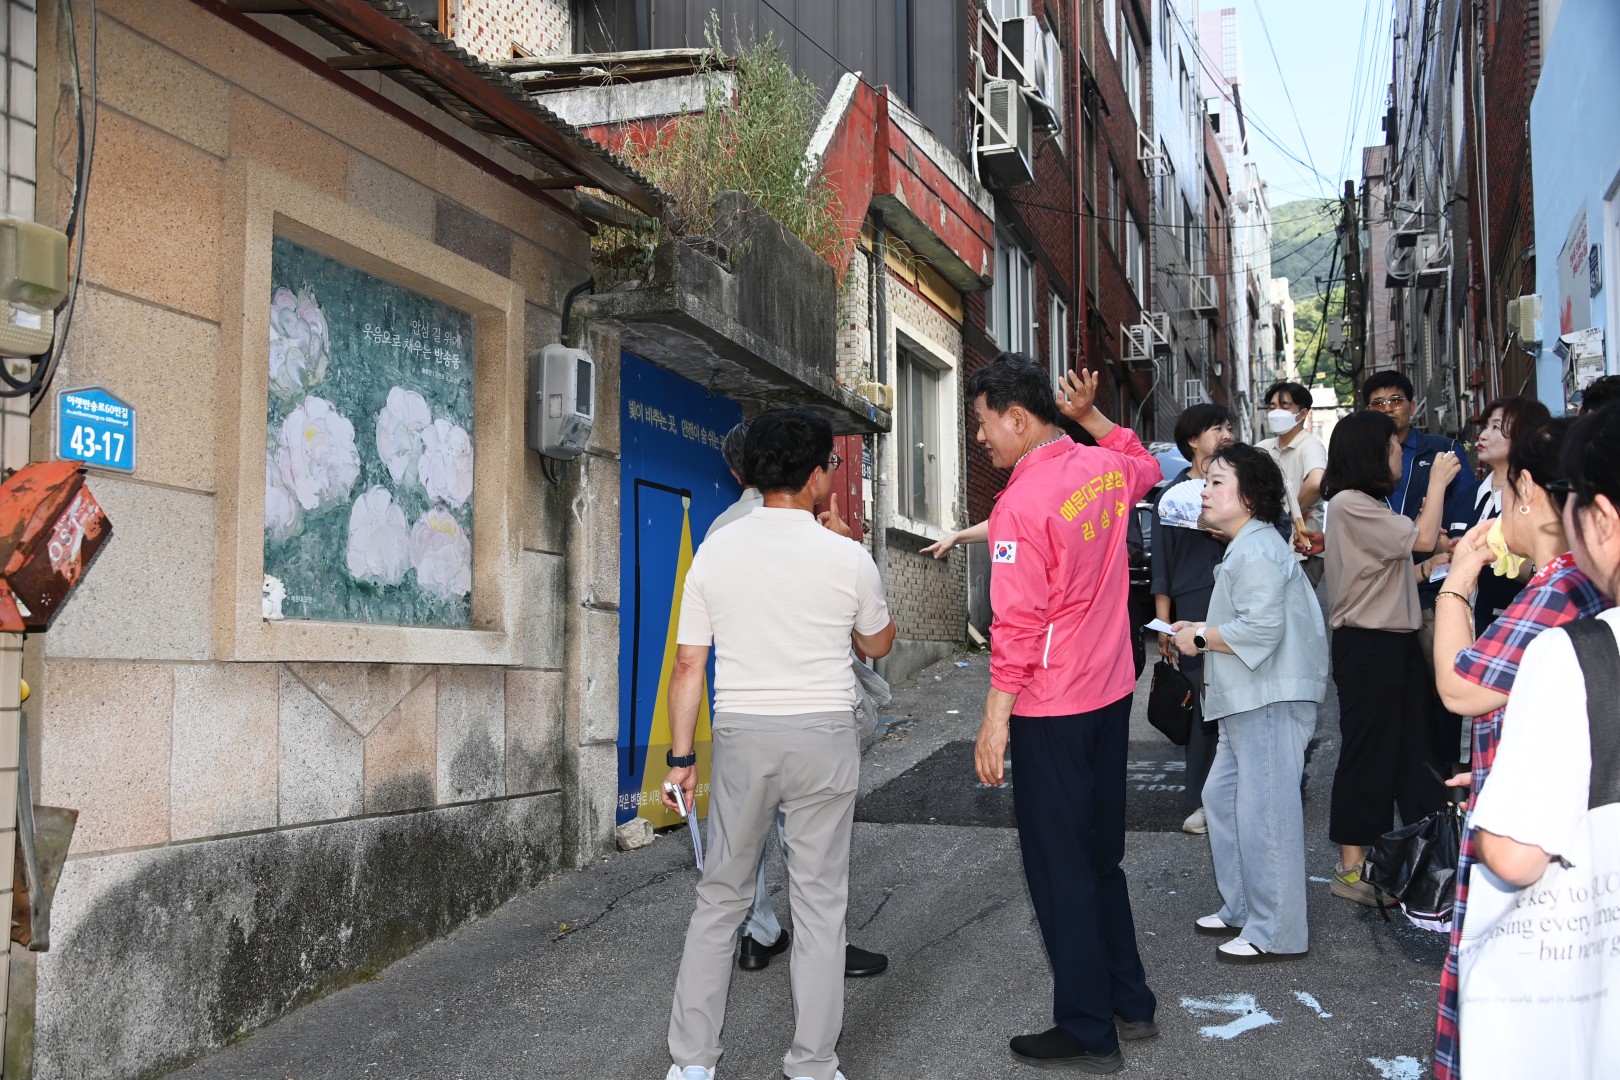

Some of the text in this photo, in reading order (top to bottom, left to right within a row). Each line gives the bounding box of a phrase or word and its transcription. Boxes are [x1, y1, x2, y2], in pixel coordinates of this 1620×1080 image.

[411, 320, 429, 338] 안심
[432, 327, 441, 343] 길
[363, 323, 461, 370] 웃음으로 채우는 반송동
[628, 400, 644, 423] 빛이
[644, 406, 667, 431] 비추는
[681, 419, 700, 443] 안전이
[70, 425, 125, 462] 43-17
[618, 793, 629, 811] 작은
[630, 790, 648, 808] 변화로
[1528, 886, 1560, 910] key
[1569, 887, 1589, 903] to
[1540, 915, 1591, 936] every
[1539, 939, 1574, 960] but
